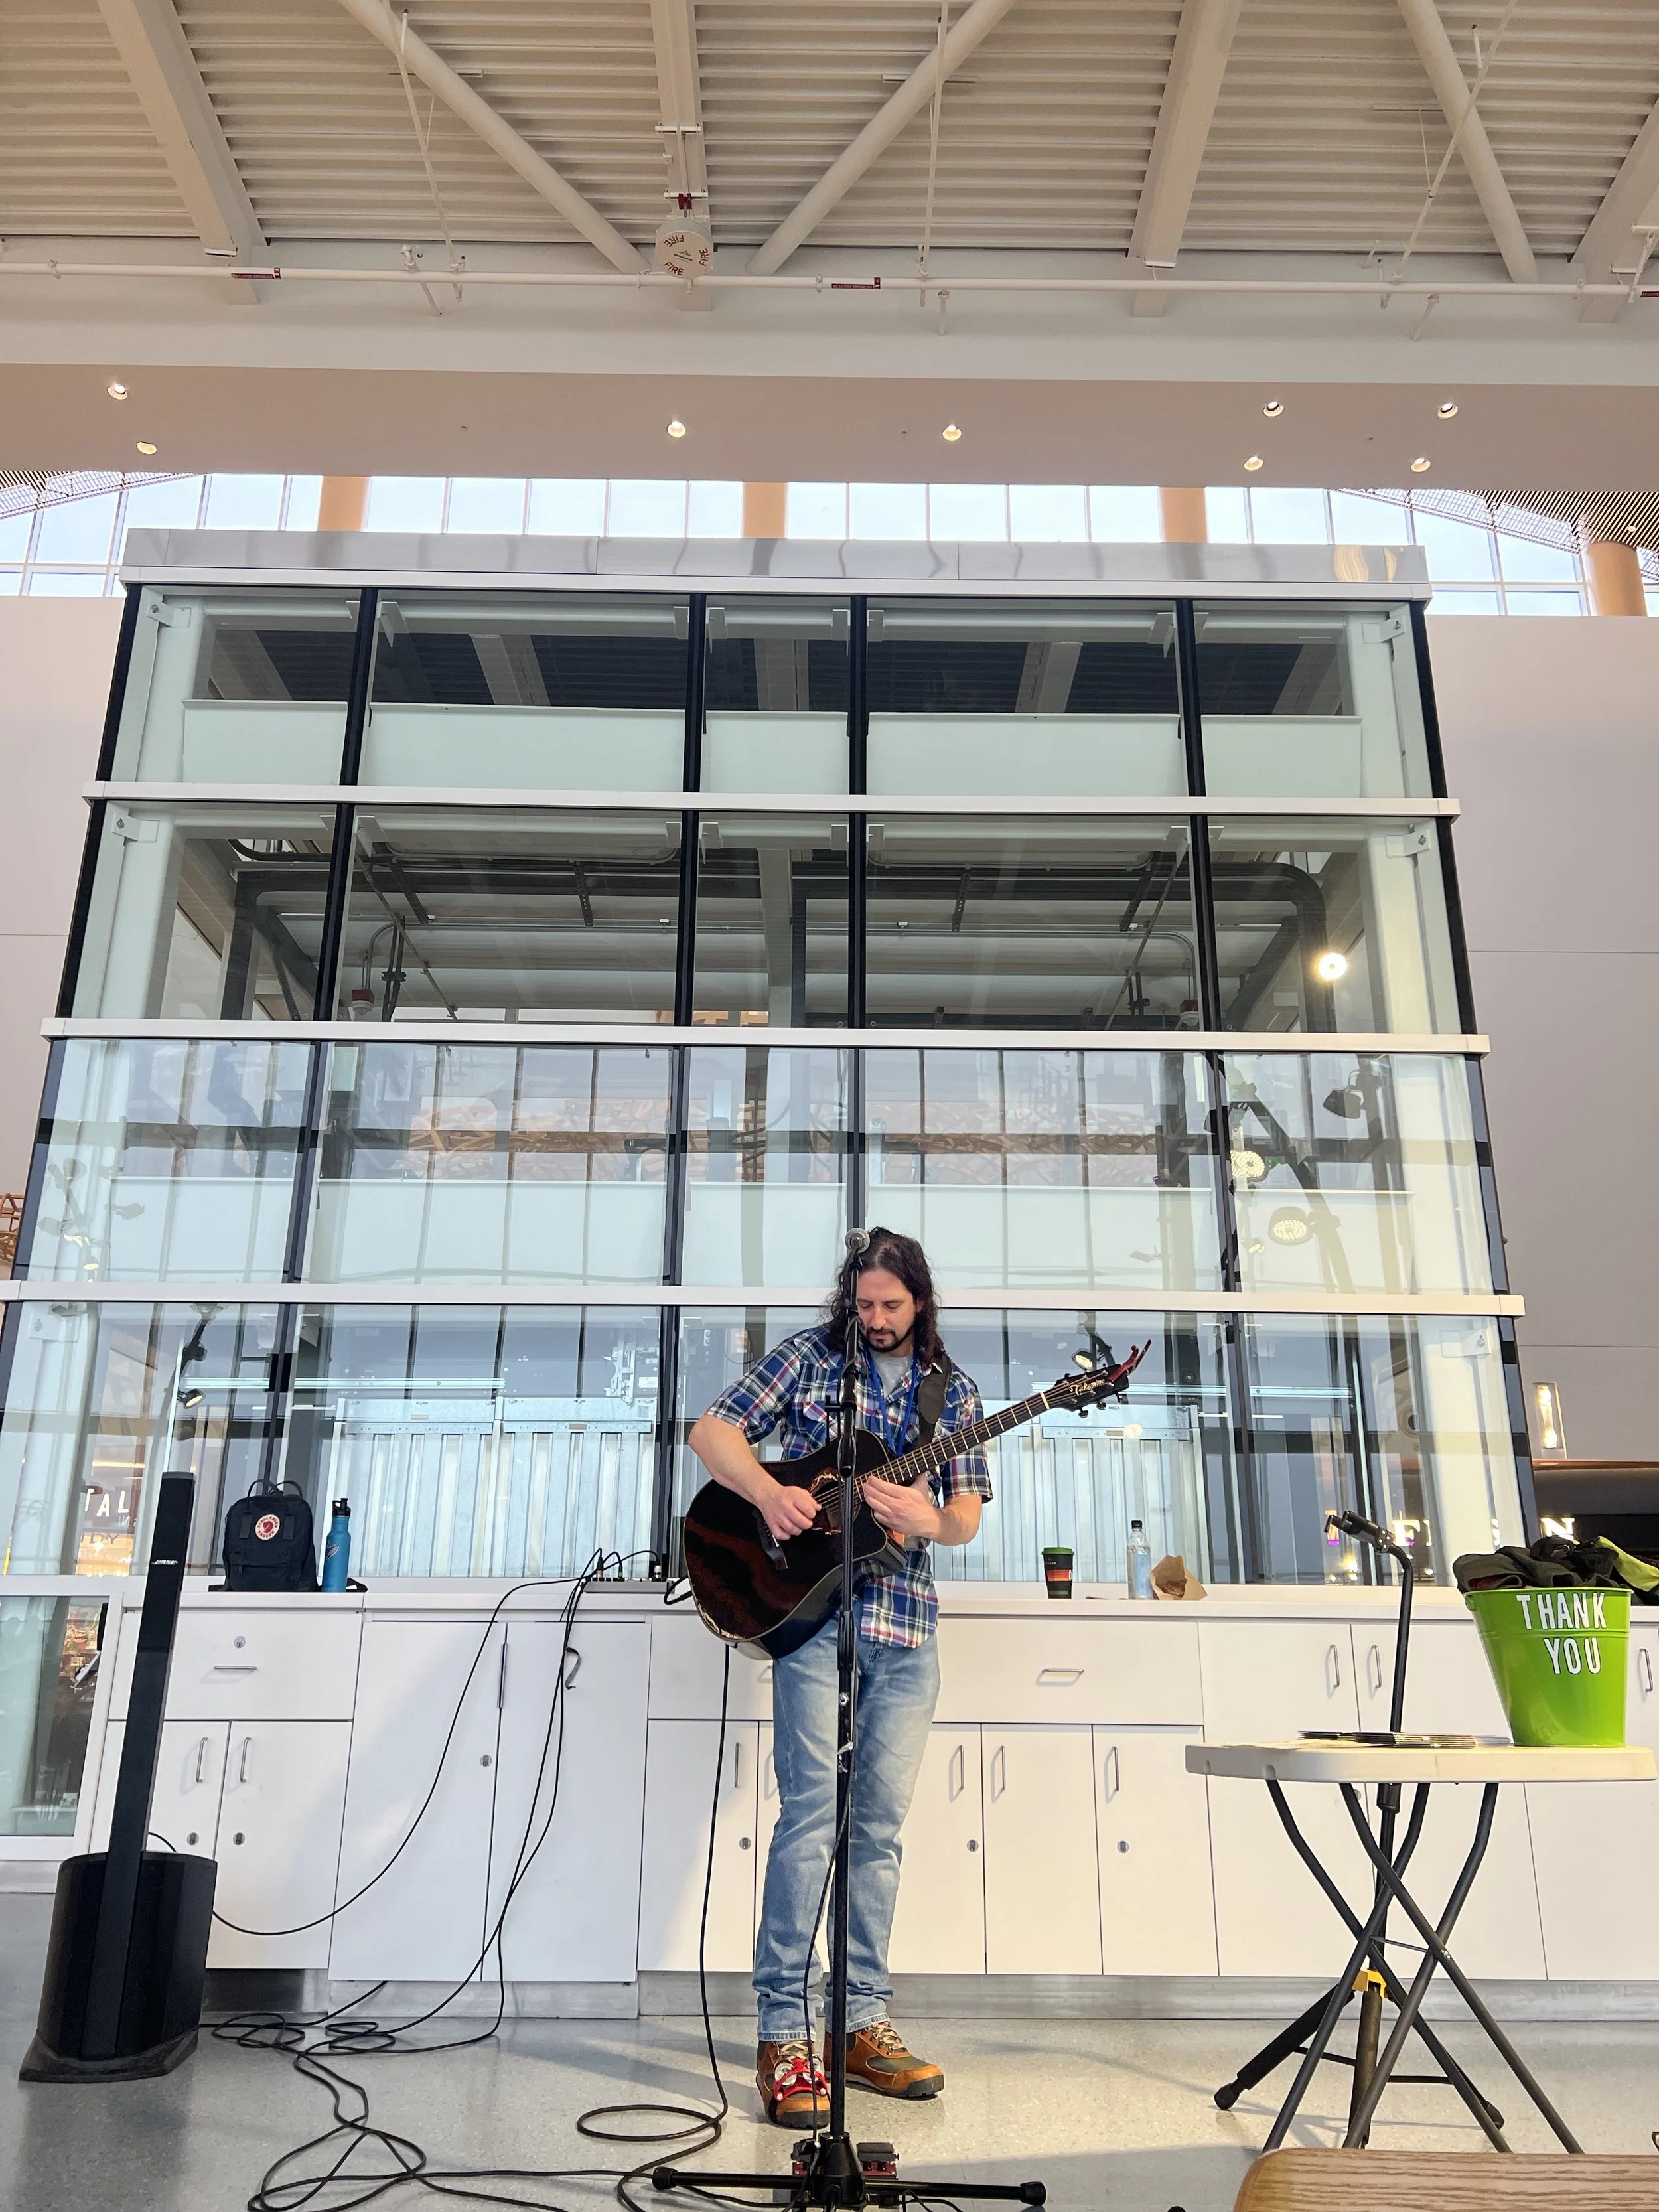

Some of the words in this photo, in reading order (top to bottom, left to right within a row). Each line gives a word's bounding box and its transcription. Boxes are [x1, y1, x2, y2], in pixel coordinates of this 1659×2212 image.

[664, 234, 684, 248] FIRE
[699, 248, 709, 267] FIRE
[664, 261, 684, 276] FIRE
[1516, 1593, 1607, 1629] THANK
[1544, 1637, 1601, 1674] YOU
